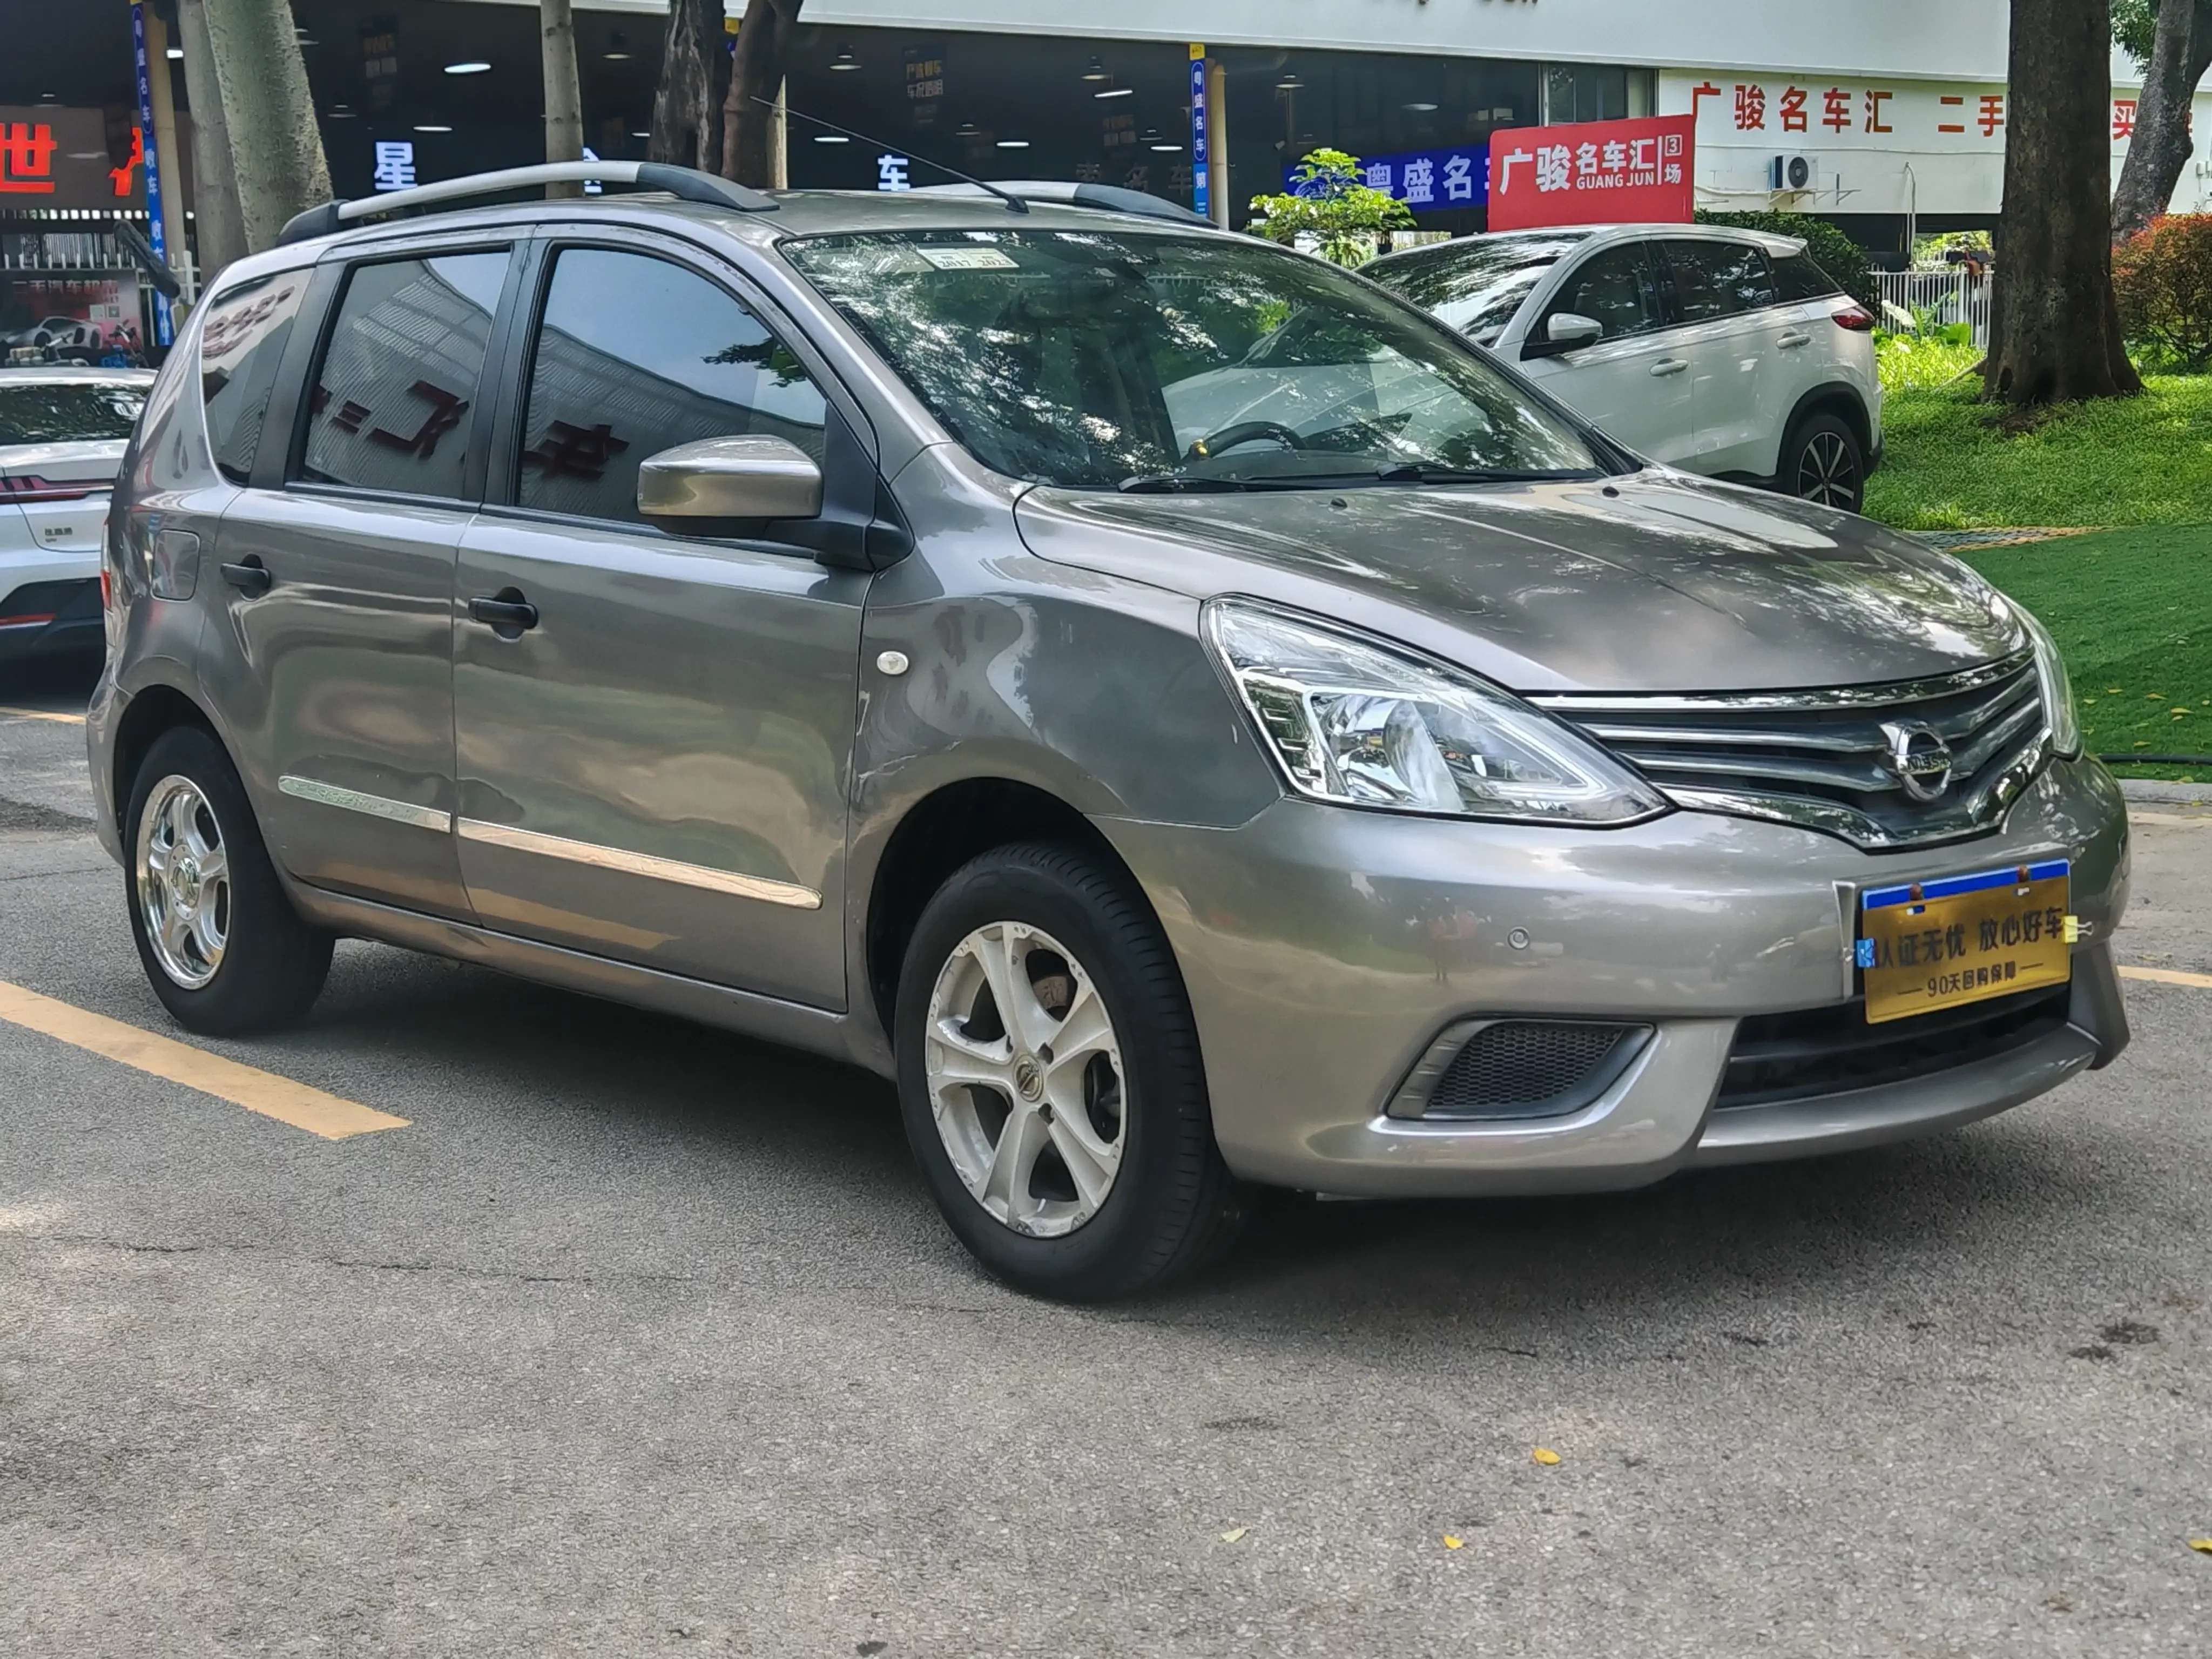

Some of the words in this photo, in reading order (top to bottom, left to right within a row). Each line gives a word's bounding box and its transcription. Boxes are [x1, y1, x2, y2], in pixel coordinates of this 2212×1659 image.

[1692, 82, 1893, 134] 广骏名车汇
[1938, 95, 2005, 137] 二手
[0, 122, 57, 193] 世
[374, 141, 418, 190] 星
[877, 154, 911, 191] 车
[1366, 154, 1491, 204] 粤盛名
[1499, 138, 1655, 195] 广骏名车汇
[1576, 173, 1623, 190] GUANG
[1626, 171, 1654, 187] JUN
[1978, 905, 2064, 953] 放心好车
